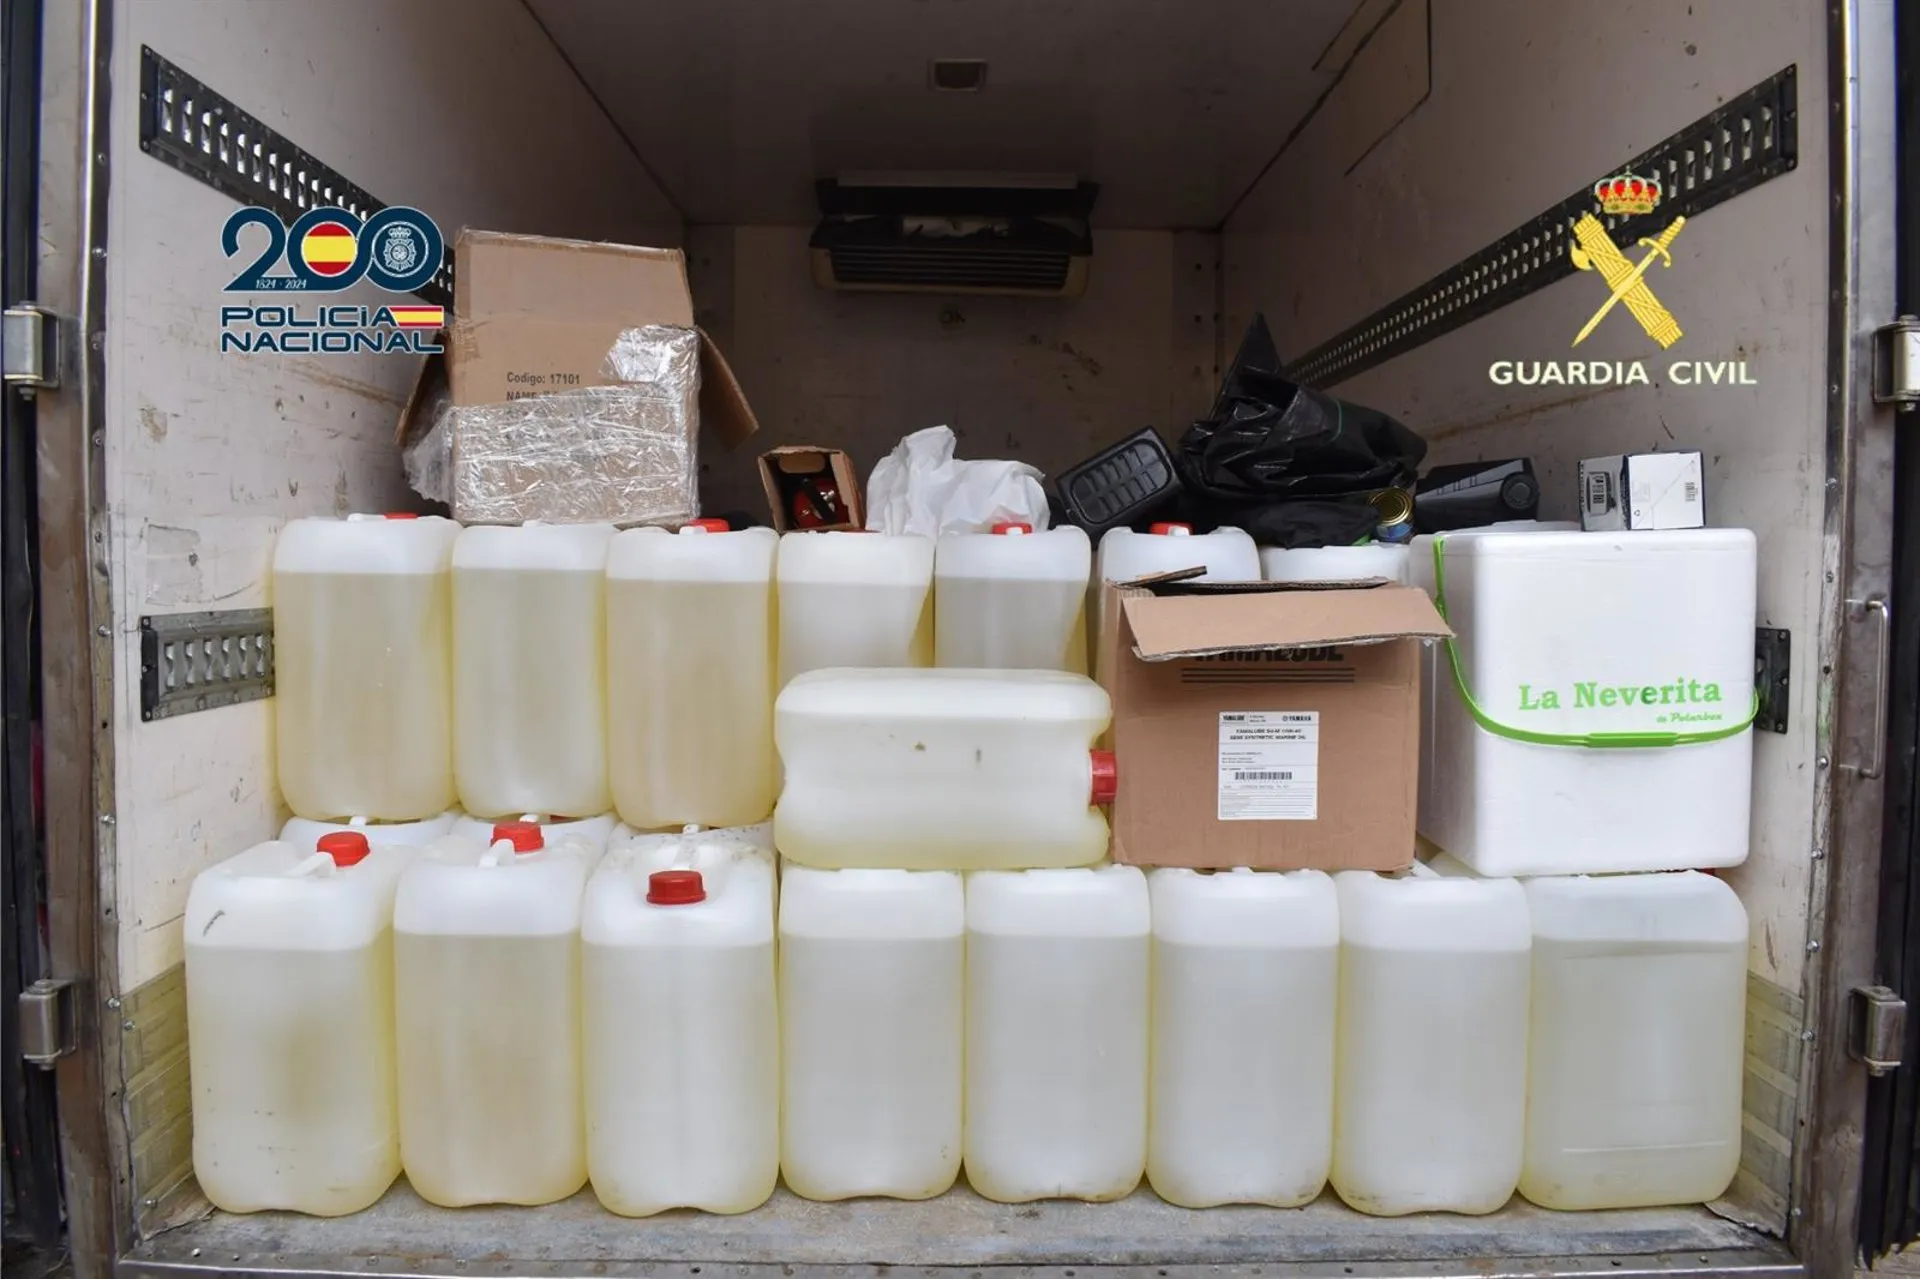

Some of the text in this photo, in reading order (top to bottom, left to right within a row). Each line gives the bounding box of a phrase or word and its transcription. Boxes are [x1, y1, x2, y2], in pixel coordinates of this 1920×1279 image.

[550, 373, 581, 385] 17101
[1518, 676, 1722, 710] La Neverita
